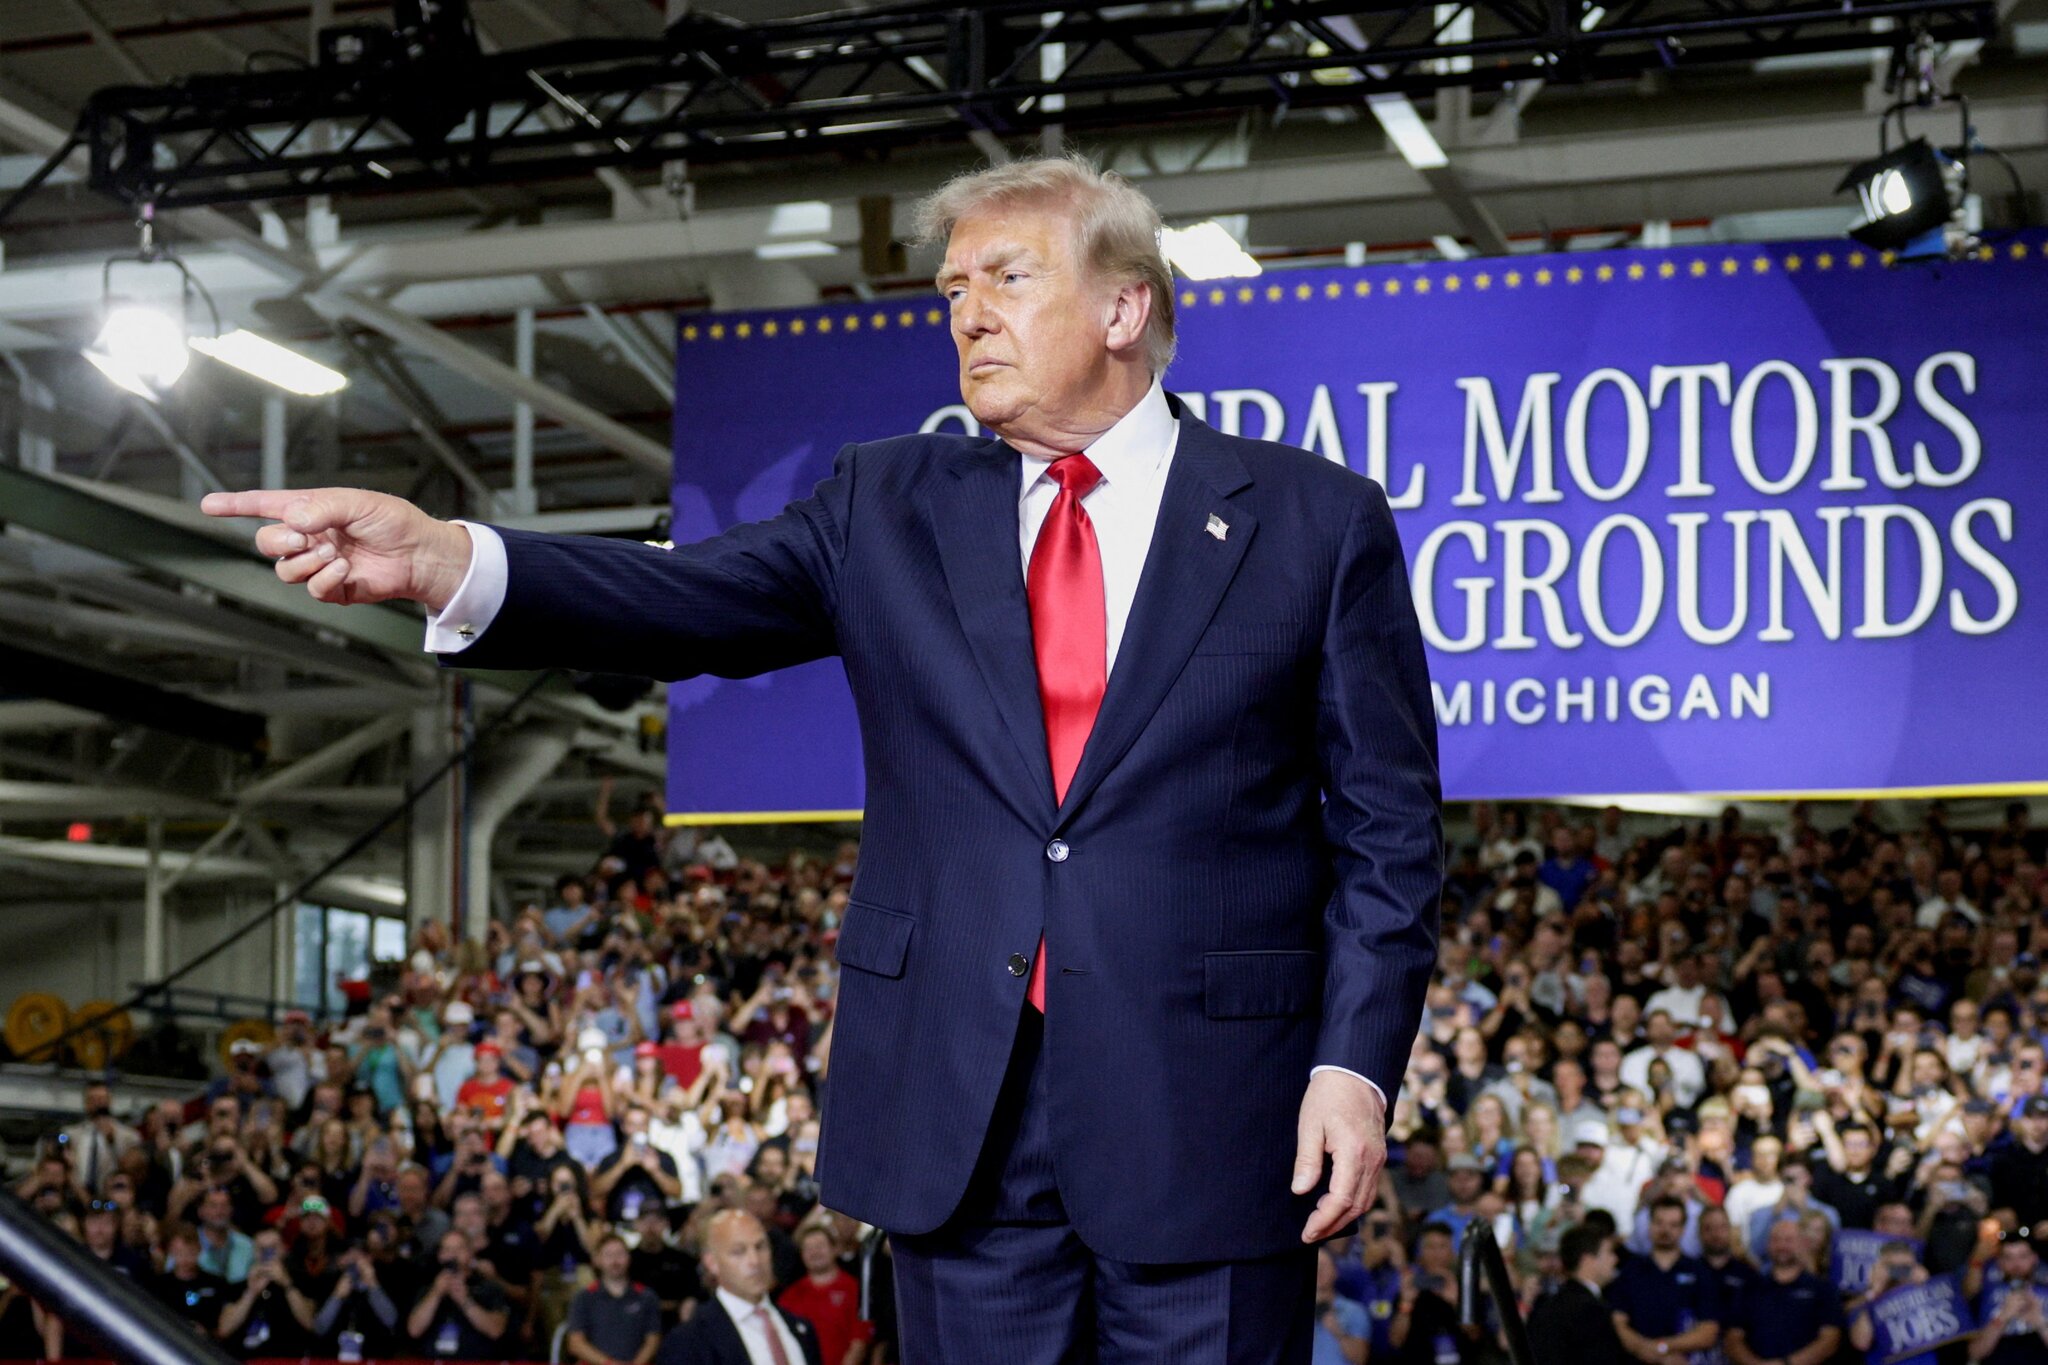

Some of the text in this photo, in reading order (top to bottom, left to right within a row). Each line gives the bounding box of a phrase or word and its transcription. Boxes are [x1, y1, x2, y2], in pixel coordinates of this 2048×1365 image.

[1451, 351, 1981, 507] MOTORS
[1411, 497, 2018, 653] GROUNDS
[1431, 671, 1770, 726] MICHIGAN
[1885, 1300, 1960, 1354] JOBS
